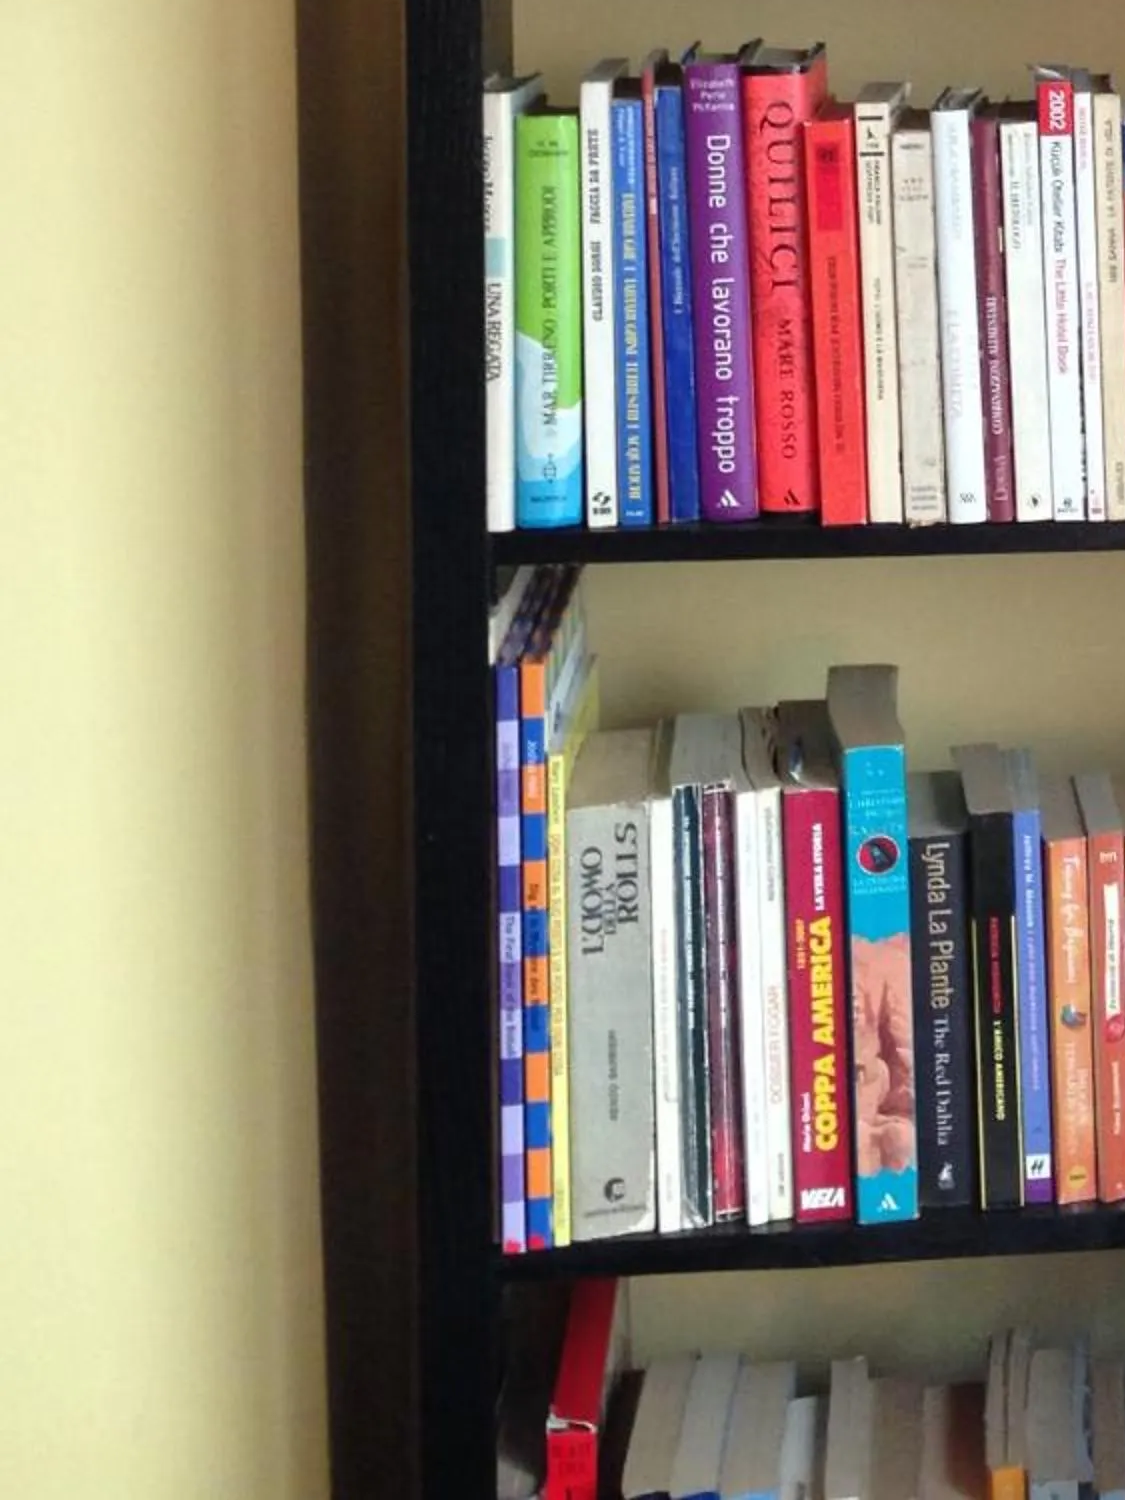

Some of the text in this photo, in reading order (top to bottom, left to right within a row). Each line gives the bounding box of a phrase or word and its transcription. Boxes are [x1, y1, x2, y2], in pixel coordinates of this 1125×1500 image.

[1048, 89, 1067, 130] 2002
[485, 282, 502, 382] UNA REGATA
[706, 134, 739, 475] Donne che lavorano troppo
[759, 100, 800, 460] QUILICI MARE ROSSO
[542, 391, 558, 426] MAR
[580, 845, 604, 955] L'UOMO
[613, 821, 640, 924] ROLLS
[808, 915, 836, 1046] AMERICA
[921, 842, 955, 1146] Lynda La Plante The Red Dahlia
[812, 1053, 839, 1151] COPPA
